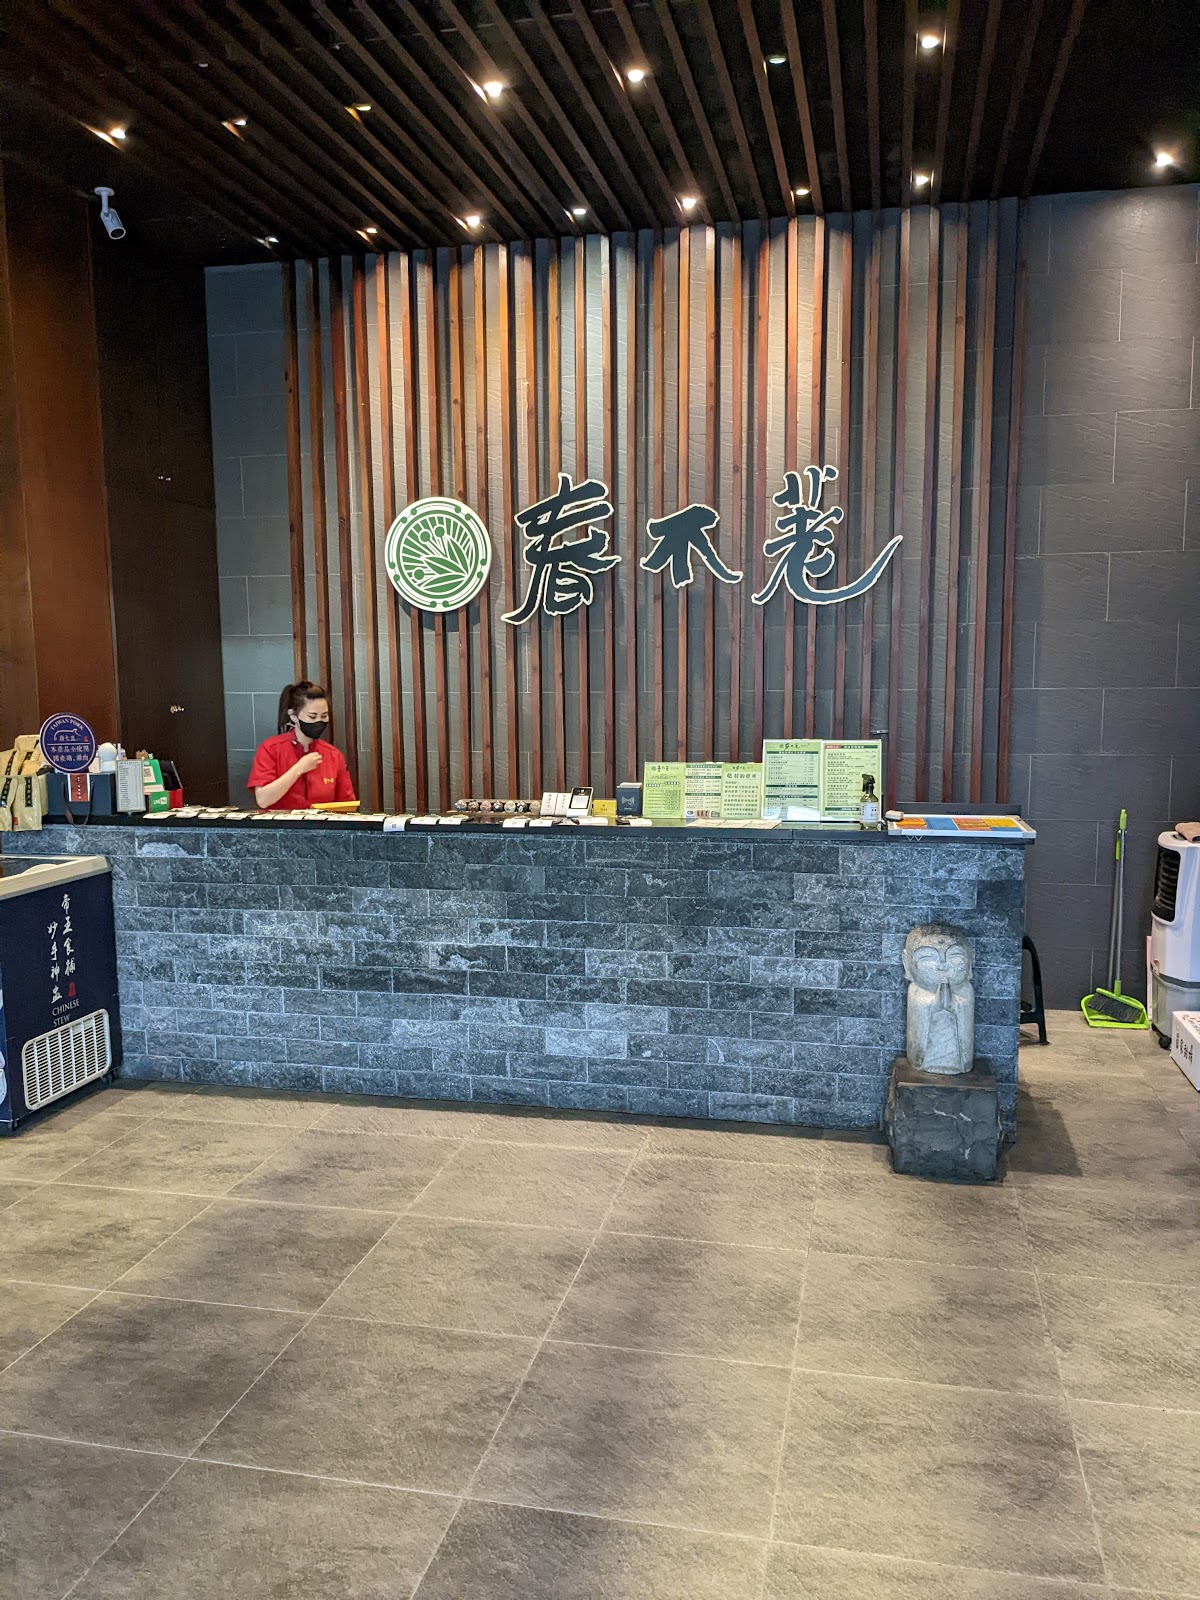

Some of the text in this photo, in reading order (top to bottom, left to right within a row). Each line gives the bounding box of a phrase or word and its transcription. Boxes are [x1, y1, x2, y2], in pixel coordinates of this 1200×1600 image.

[50, 718, 85, 731] TAIWAN PORK
[52, 998, 80, 1017] CHINESE
[53, 1014, 72, 1027] STEW
